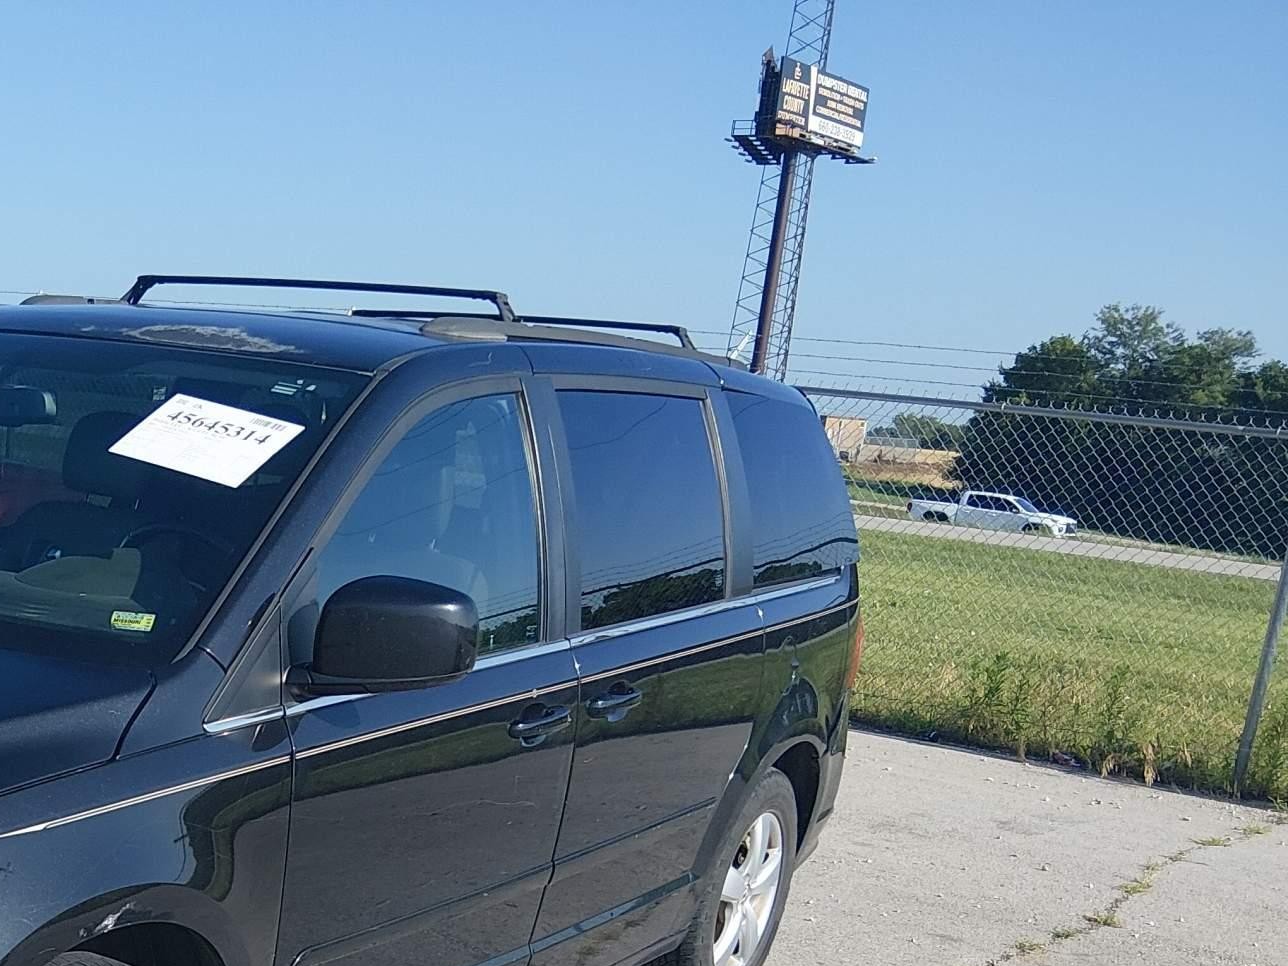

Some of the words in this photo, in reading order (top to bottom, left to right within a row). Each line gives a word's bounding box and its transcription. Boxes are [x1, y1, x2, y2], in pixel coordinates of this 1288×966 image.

[782, 78, 809, 99] LAFAYETTE
[818, 74, 847, 93] DUMPSTER
[848, 85, 867, 102] RENTAL
[783, 95, 804, 114] COUNTY
[167, 410, 273, 445] 45645314
